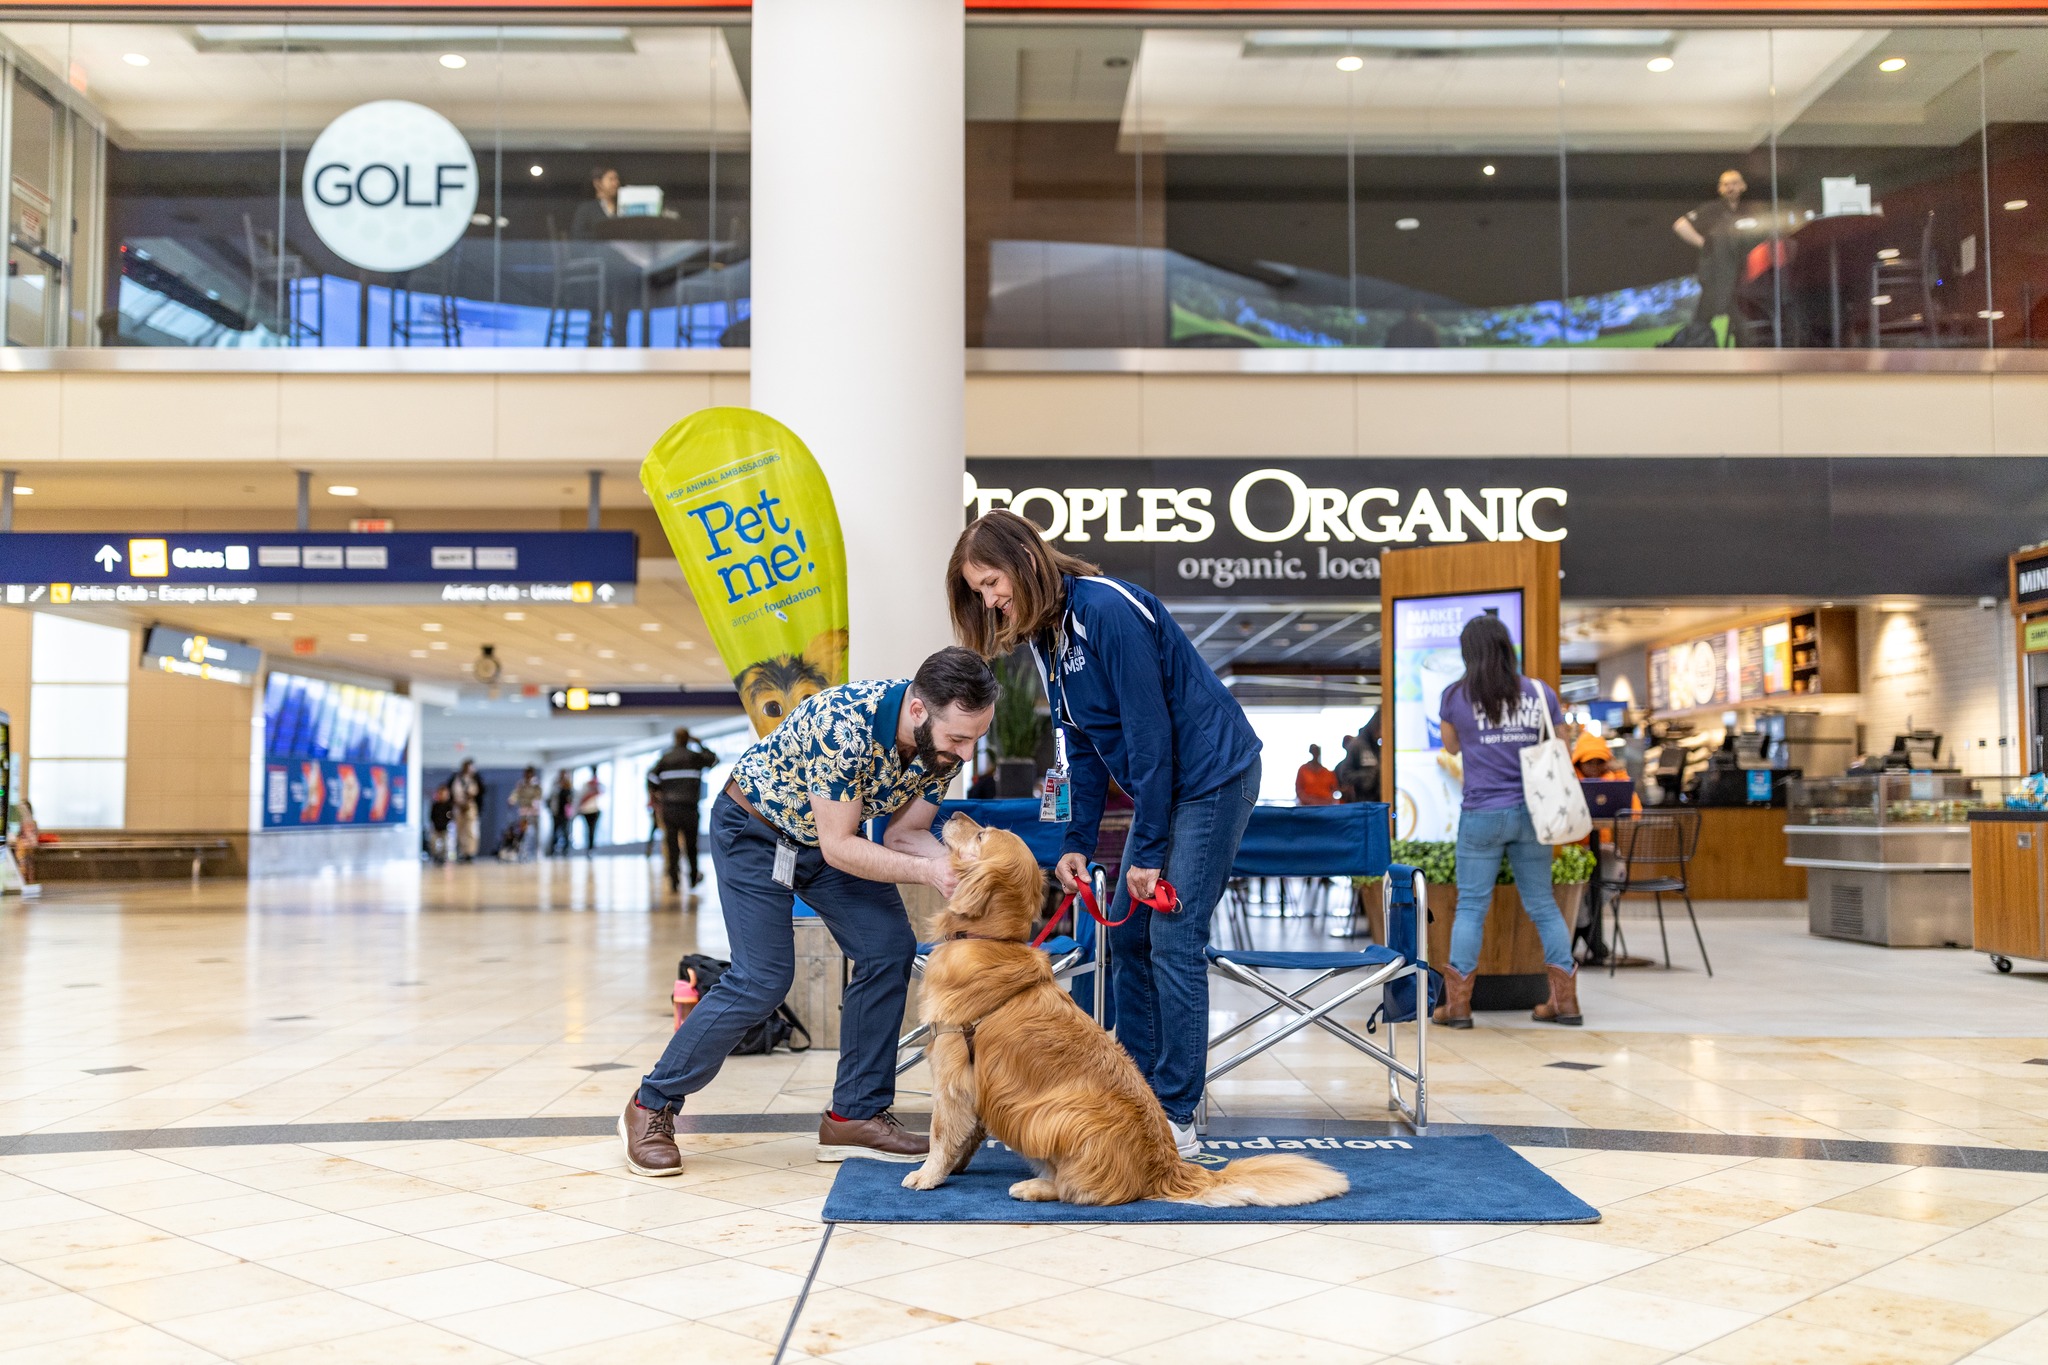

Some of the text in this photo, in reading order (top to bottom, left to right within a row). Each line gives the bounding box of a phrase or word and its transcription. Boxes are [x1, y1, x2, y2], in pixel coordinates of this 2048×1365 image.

[314, 163, 468, 207] GOLF
[666, 453, 781, 501] MSP ANIMAL AMBASSADORS
[687, 489, 790, 562] Pet
[1230, 469, 1568, 542] ORGANIC
[717, 529, 815, 604] me!
[1177, 546, 1391, 588] organic. loca
[71, 585, 115, 601] Airline
[116, 585, 148, 601] Club
[158, 584, 207, 603] Escape
[207, 585, 257, 604] Lounge
[731, 585, 821, 628] airport foundation
[1406, 607, 1464, 623] MARKET
[1063, 655, 1086, 675] MSP
